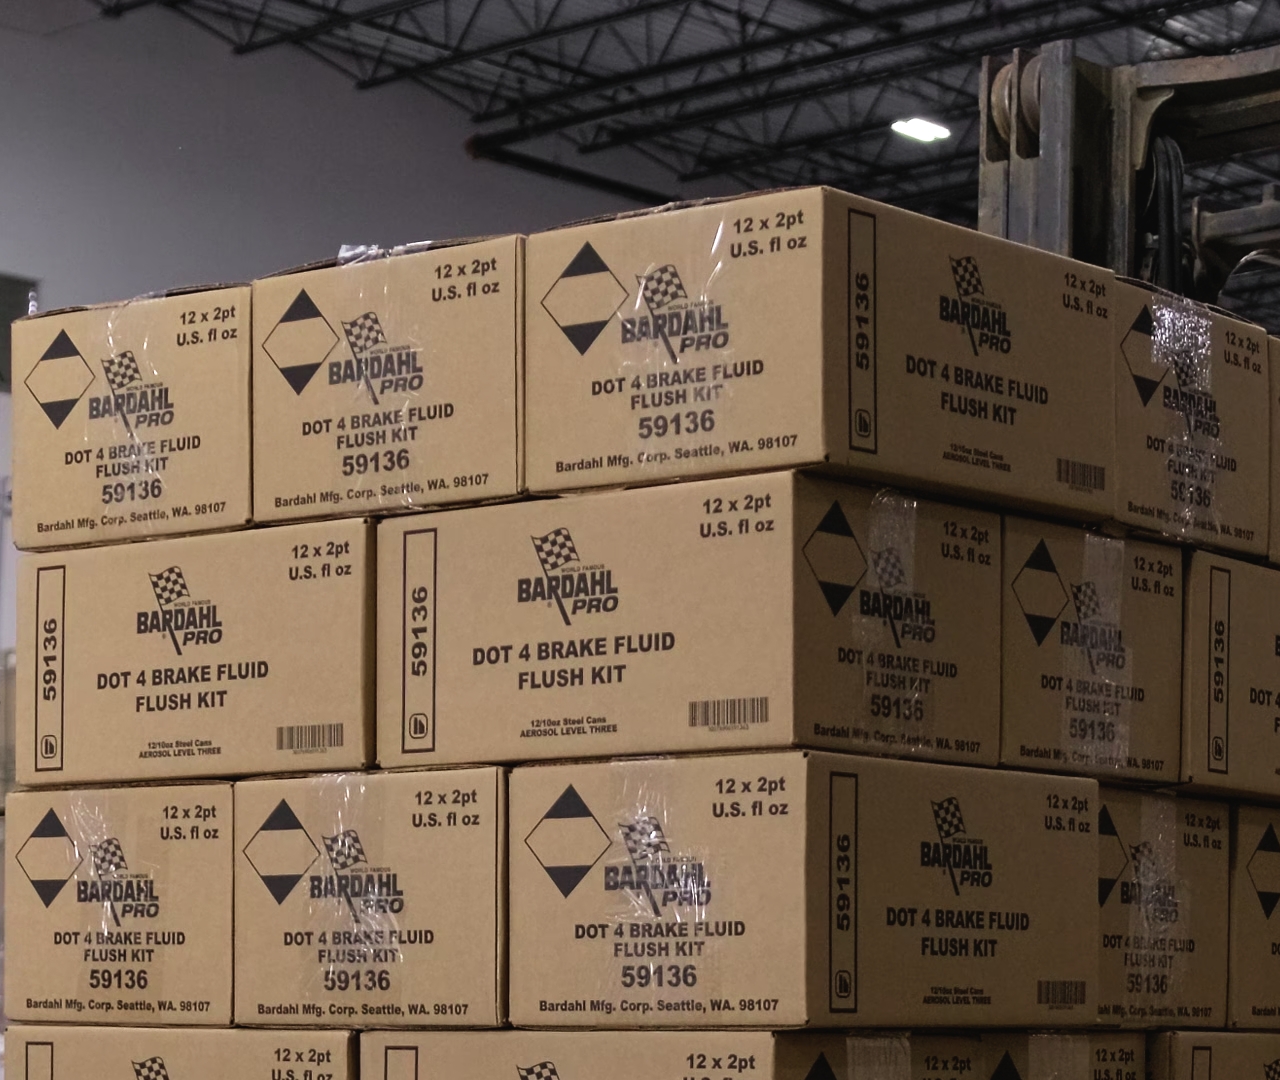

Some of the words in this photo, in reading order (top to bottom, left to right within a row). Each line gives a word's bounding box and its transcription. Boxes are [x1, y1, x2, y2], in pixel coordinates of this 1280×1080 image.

[733, 217, 753, 234] 12
[758, 218, 768, 230] x
[776, 208, 803, 231] 2pt
[430, 285, 460, 303] U.S.
[467, 282, 476, 297] fl
[482, 281, 499, 294] oz
[180, 310, 195, 325] 12
[200, 312, 207, 322] x
[213, 304, 234, 323] 2pt
[855, 271, 869, 371] 59136
[940, 296, 1009, 336] BARDAHL
[979, 332, 1010, 354] PRO
[89, 387, 173, 419] BARDAHL
[940, 390, 986, 417] FLUSH
[991, 402, 1014, 423] KIT
[135, 410, 174, 429] PRO
[302, 418, 331, 436] DOT
[336, 416, 345, 431] 4
[351, 408, 402, 429] BRAKE
[409, 401, 454, 421] FLUID
[638, 408, 715, 440] 59136
[342, 448, 410, 477] 59136
[556, 456, 602, 472] Bardahl
[607, 454, 631, 469] Mfg.
[637, 450, 669, 466] Corp.
[675, 443, 724, 461] Seattle,
[729, 440, 753, 453] WA.
[758, 434, 798, 449] 98107
[100, 478, 162, 504] 59136
[518, 569, 618, 602] BARDAHL
[572, 595, 619, 614] PRO
[861, 591, 936, 624] BARDAHL
[136, 605, 221, 633] BARDAHL
[412, 587, 427, 677] 59136
[183, 628, 222, 645] PRO
[902, 624, 936, 644] PRO
[43, 618, 56, 701] 59136
[473, 644, 511, 664] DOT
[518, 643, 529, 660] 4
[536, 637, 606, 659] BRAKE
[614, 631, 677, 653] FLUID
[838, 646, 862, 664] DOT
[866, 651, 874, 666] 4
[878, 653, 919, 672] BRAKE
[923, 659, 958, 678] FLUID
[1213, 620, 1224, 704] 59136
[136, 693, 191, 712] FLUSH
[198, 690, 227, 707] KIT
[414, 790, 432, 805] 12
[437, 793, 446, 804] x
[452, 788, 477, 807] 2pt
[921, 843, 991, 869] BARDAHL
[77, 880, 158, 901] BARDAHL
[837, 835, 849, 931] 59136
[960, 871, 993, 886] PRO
[121, 903, 159, 917] PRO
[54, 932, 79, 944] DOT
[84, 932, 91, 944] 4
[96, 932, 140, 944] BRAKE
[146, 931, 185, 944] FLUID
[575, 924, 607, 939] DOT
[613, 924, 624, 938] 4
[630, 922, 687, 937] BRAKE
[694, 920, 745, 936] FLUID
[83, 949, 125, 961] FLUSH
[131, 949, 154, 961] KIT
[613, 942, 668, 957] FLUSH
[675, 941, 705, 955] KIT
[89, 969, 147, 989] 59136
[621, 964, 697, 987] 59136
[539, 1000, 585, 1010] Bardahl
[590, 1000, 614, 1013] Mfg.
[620, 1001, 652, 1013] Corp.
[657, 1000, 705, 1012] Seattle,
[710, 1000, 734, 1010] WA.
[739, 1000, 779, 1010] 98107
